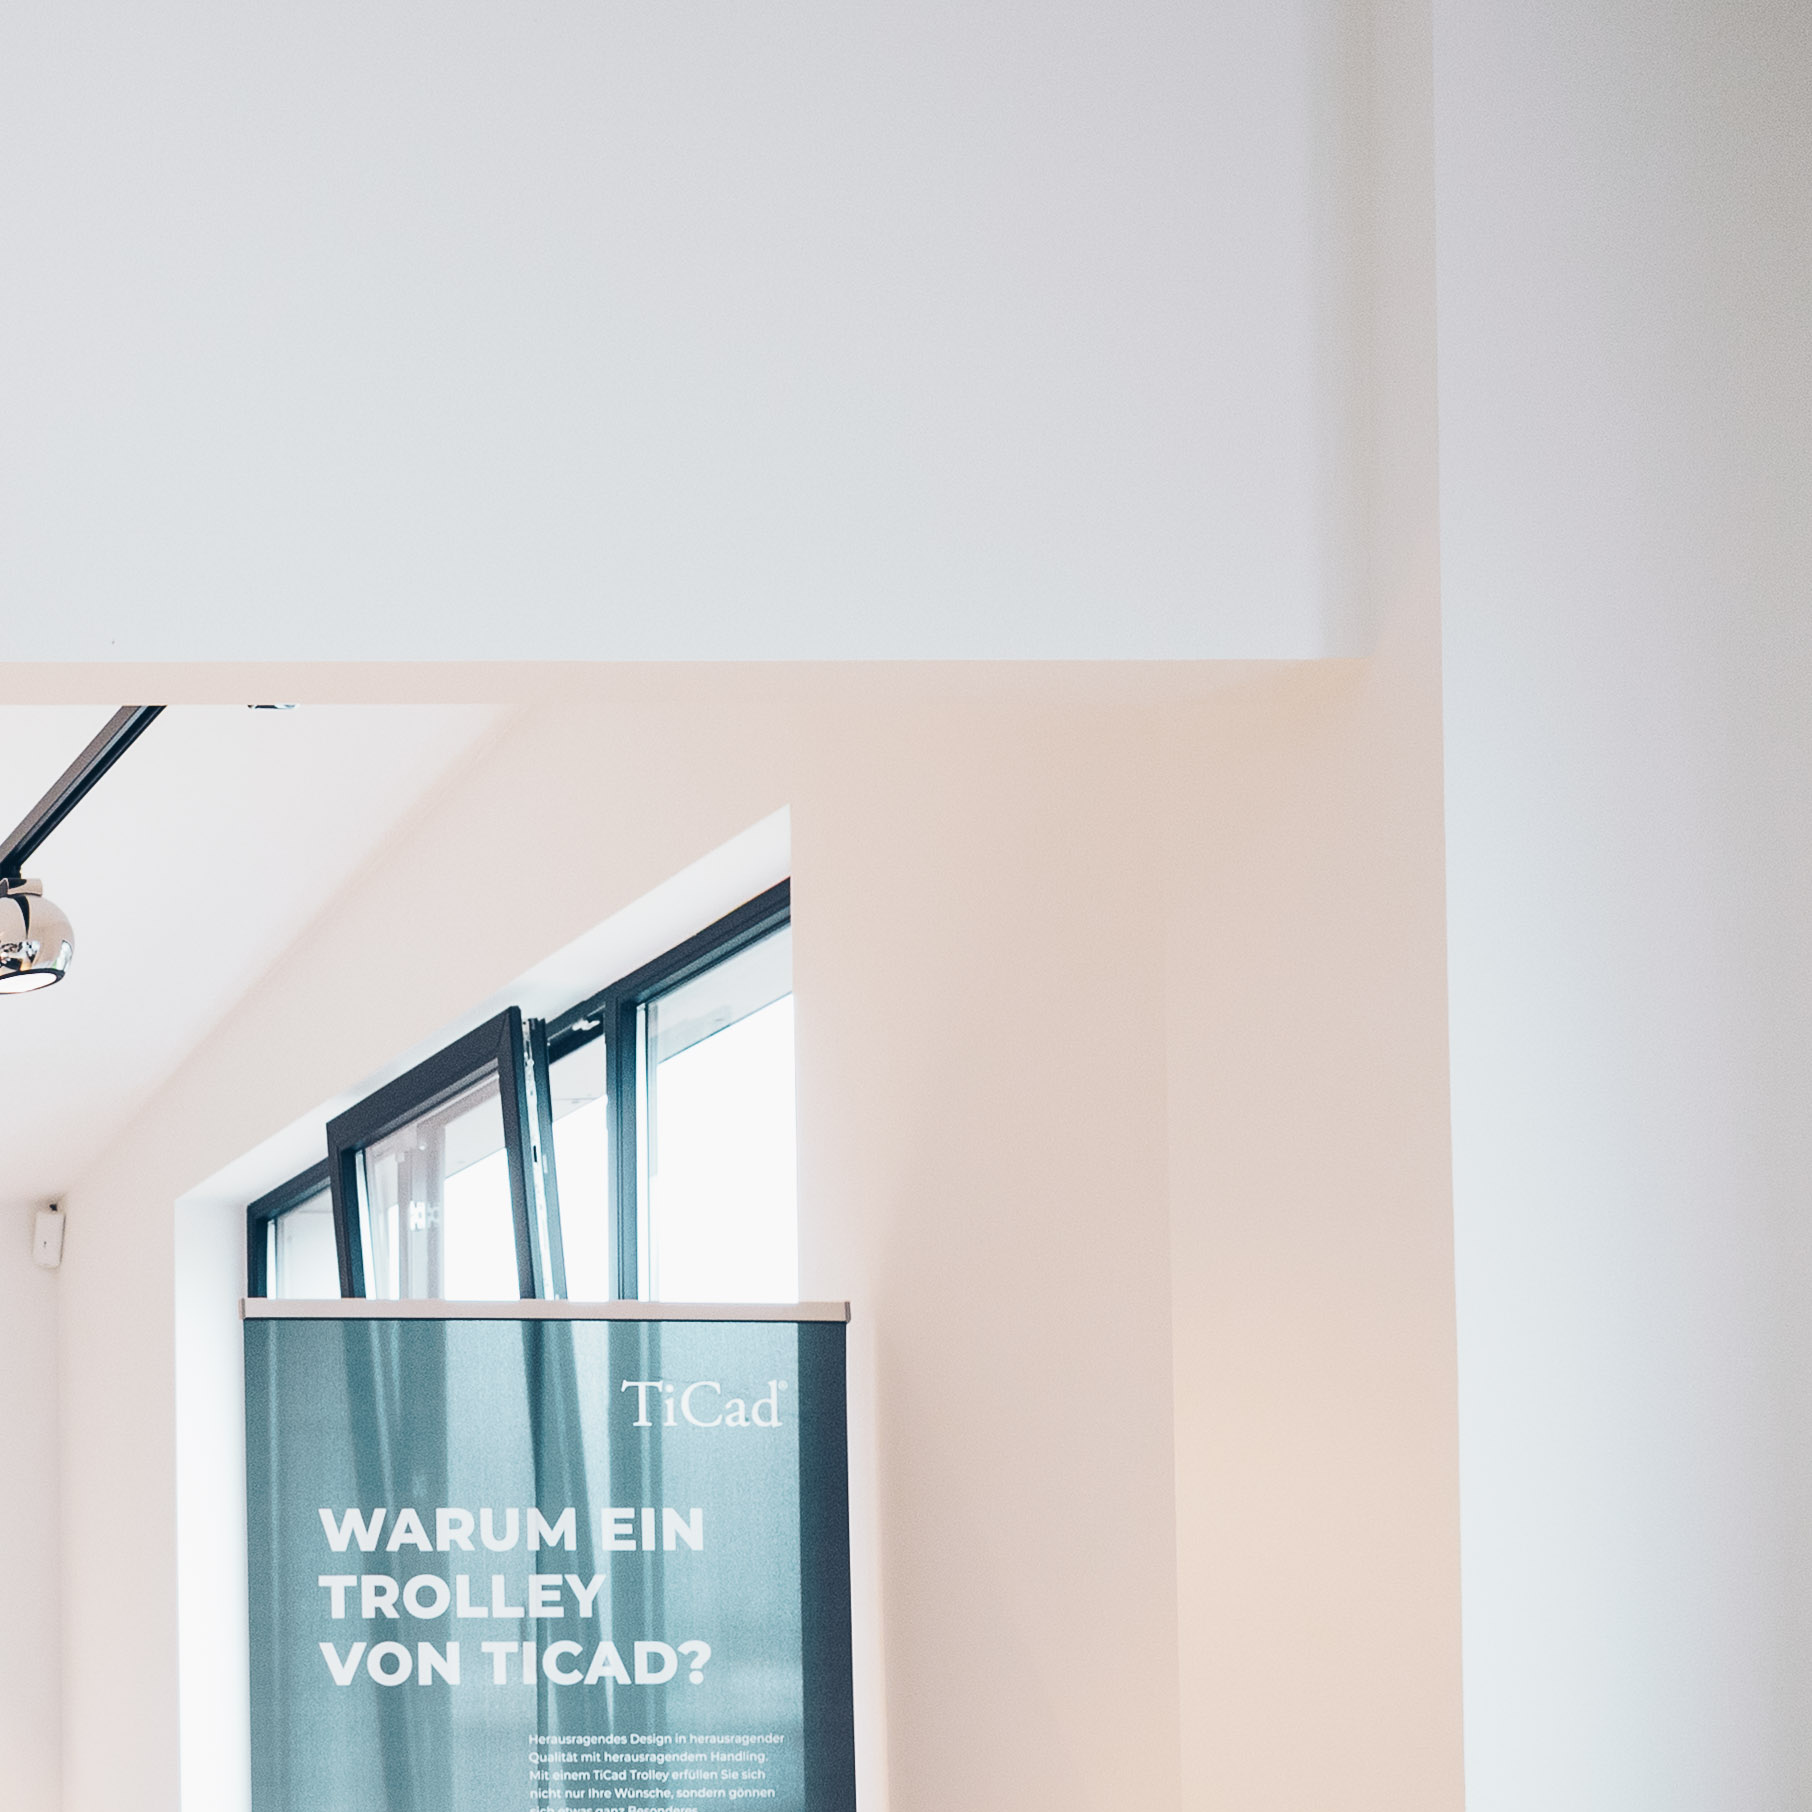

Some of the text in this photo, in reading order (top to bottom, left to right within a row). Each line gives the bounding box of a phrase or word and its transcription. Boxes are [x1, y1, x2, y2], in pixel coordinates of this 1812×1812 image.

[318, 1507, 704, 1552] WARUM EIN
[318, 1573, 607, 1620] TROLLEY
[319, 1639, 712, 1686] VON TICAD?
[528, 1732, 784, 1747] Herausragendes Design in herausragender
[528, 1751, 769, 1764] Qualität mit herausragendem Handling.
[529, 1768, 766, 1783] Mit einem TiCad Trolley erfüllen Sie sich
[529, 1787, 775, 1800] nicht nur Ihre Wünsche, sondern gönnen
